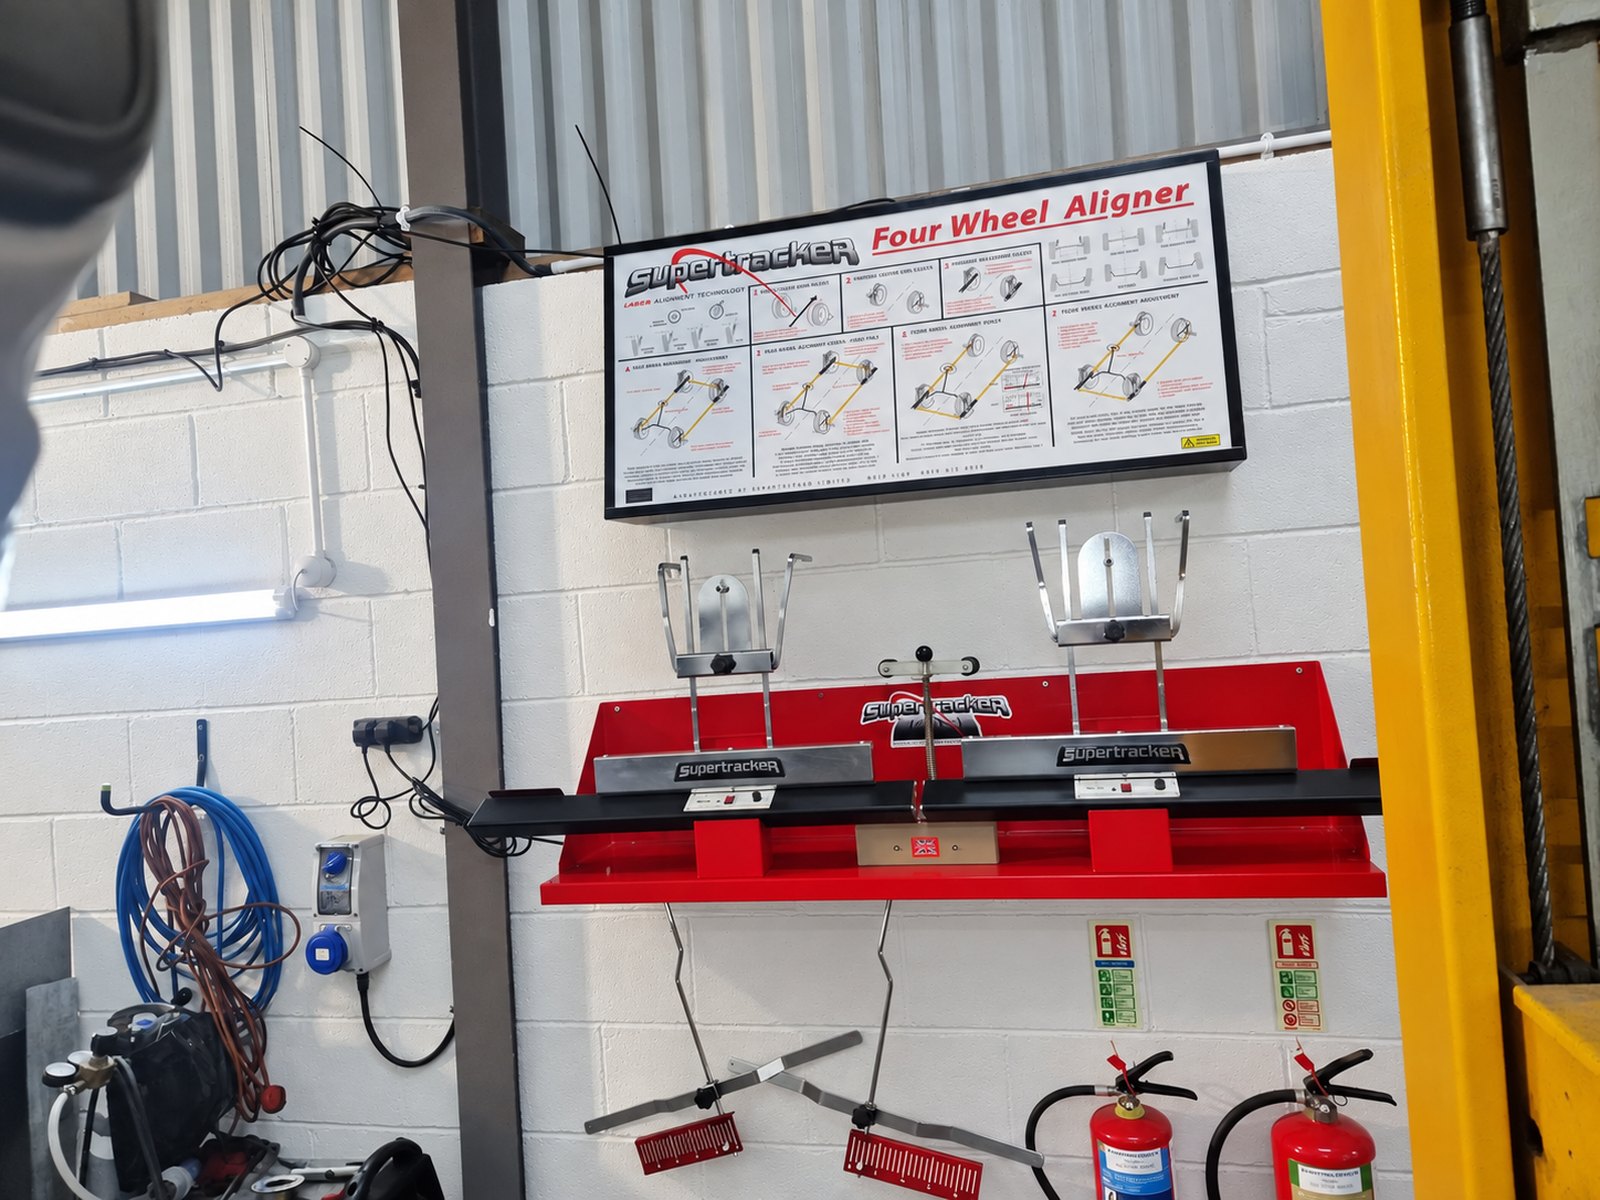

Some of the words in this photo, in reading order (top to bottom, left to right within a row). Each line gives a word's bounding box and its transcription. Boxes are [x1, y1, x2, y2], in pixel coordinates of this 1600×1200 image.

[871, 222, 942, 250] Four
[950, 199, 1049, 238] Wheel
[1064, 182, 1190, 220] Aligner
[697, 286, 746, 299] TECHNOLOGY
